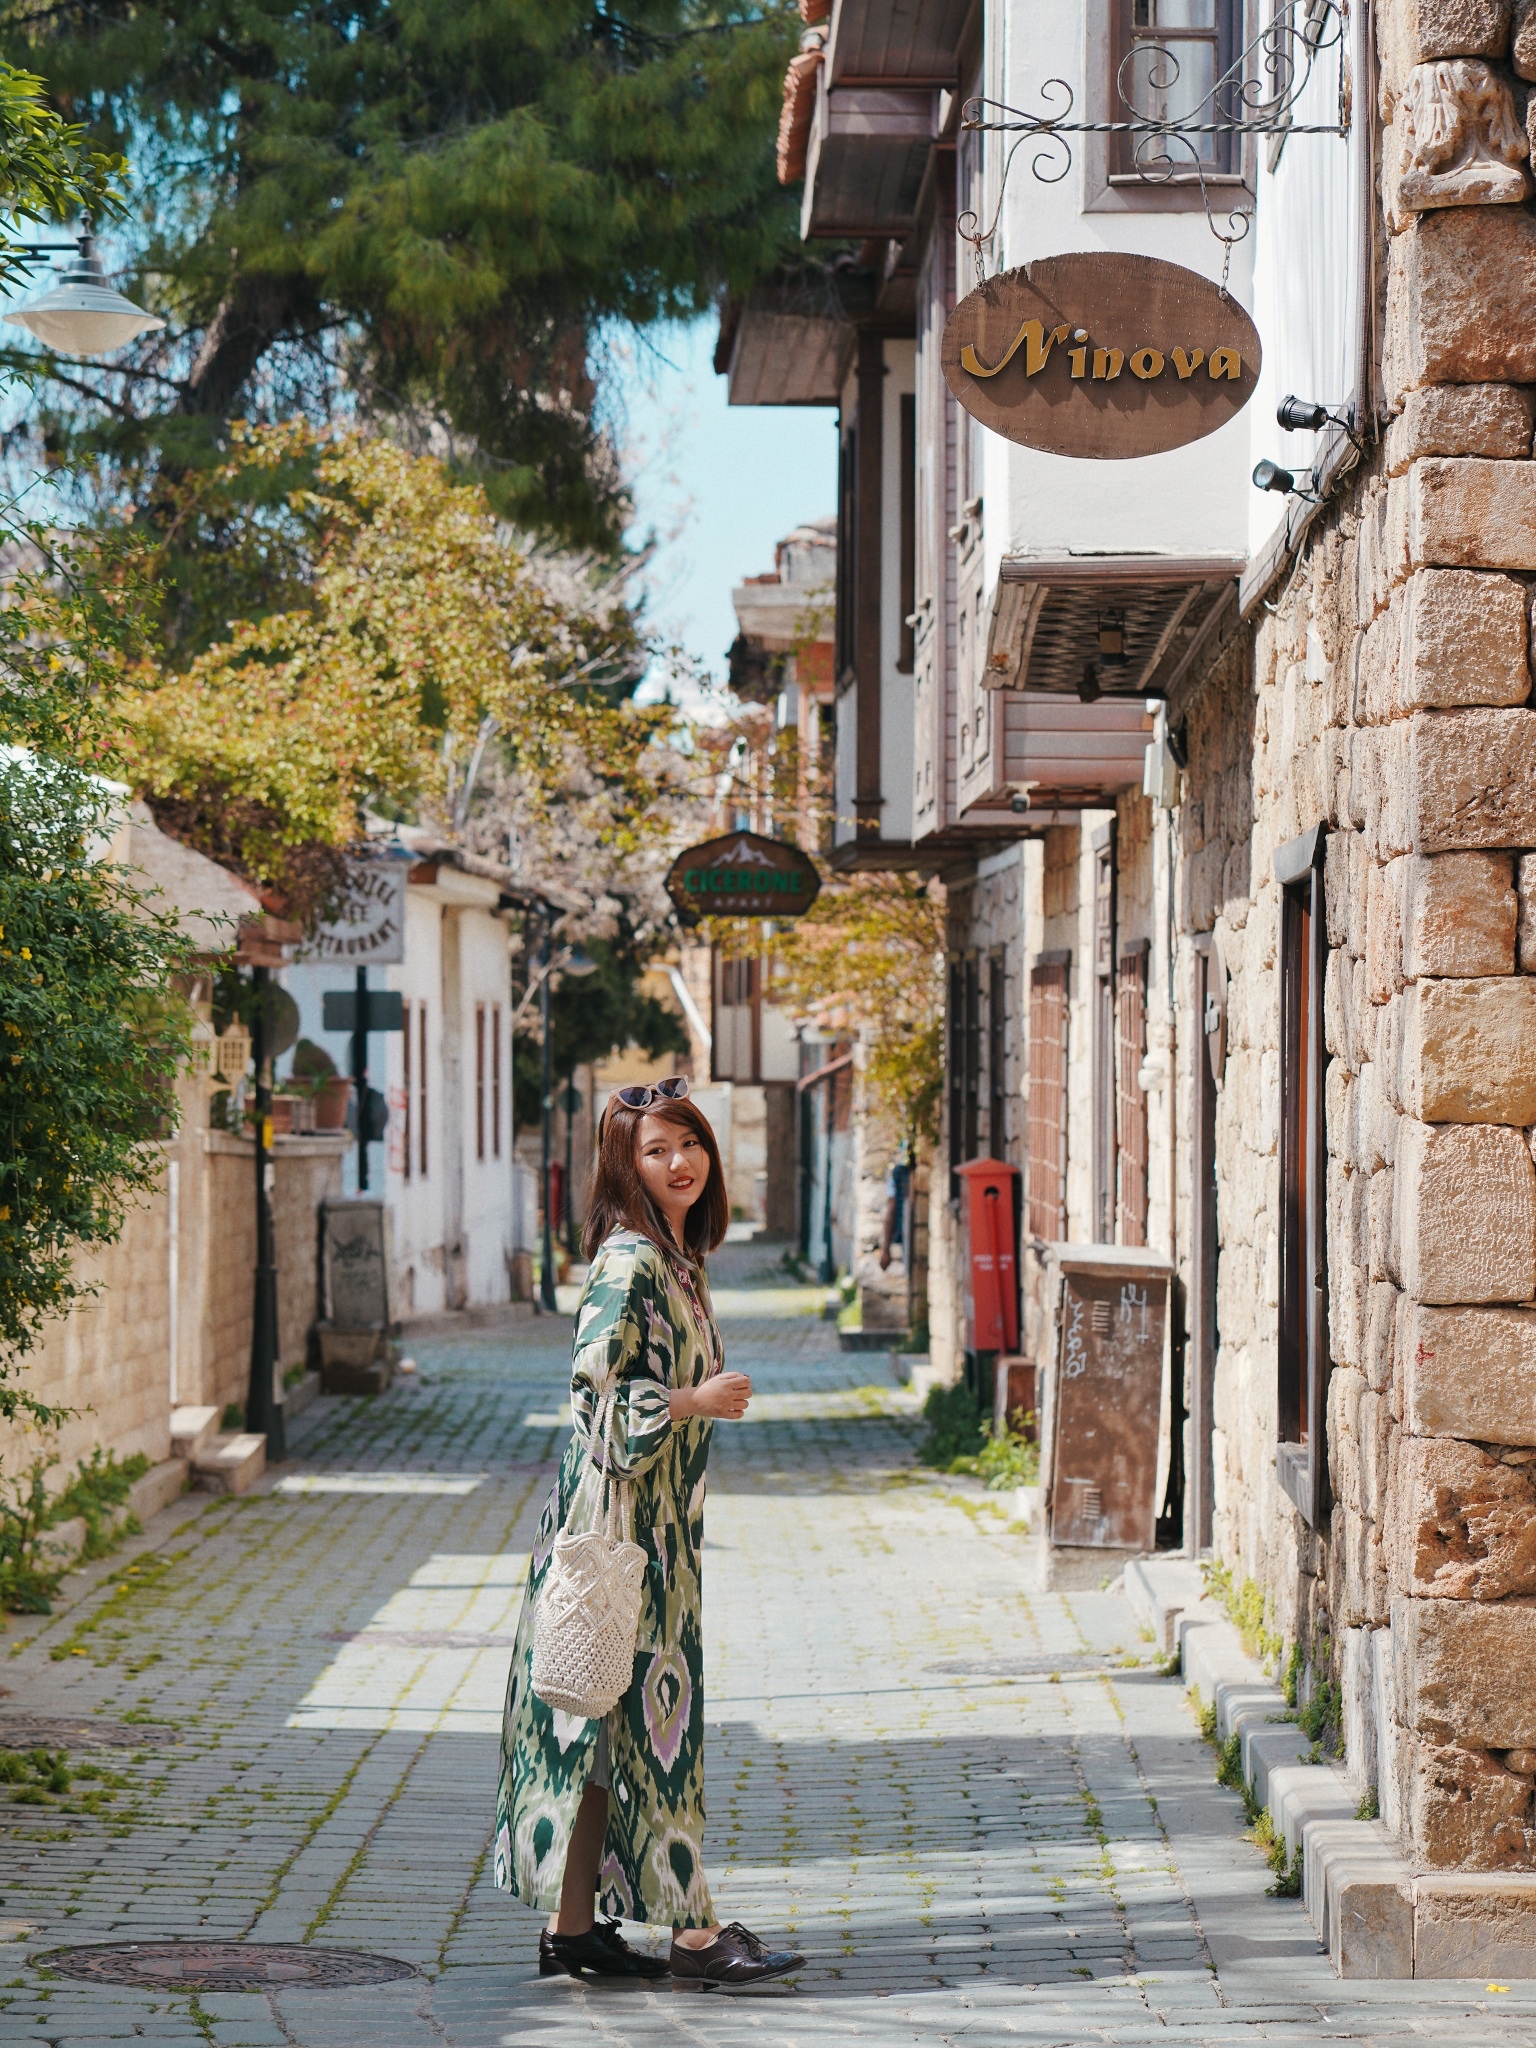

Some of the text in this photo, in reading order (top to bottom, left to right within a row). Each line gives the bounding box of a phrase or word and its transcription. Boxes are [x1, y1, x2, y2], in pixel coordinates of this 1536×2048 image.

[960, 318, 1241, 381] Ninova
[347, 870, 396, 906] OTEL
[684, 868, 802, 894] CICERONE
[713, 897, 773, 908] APART
